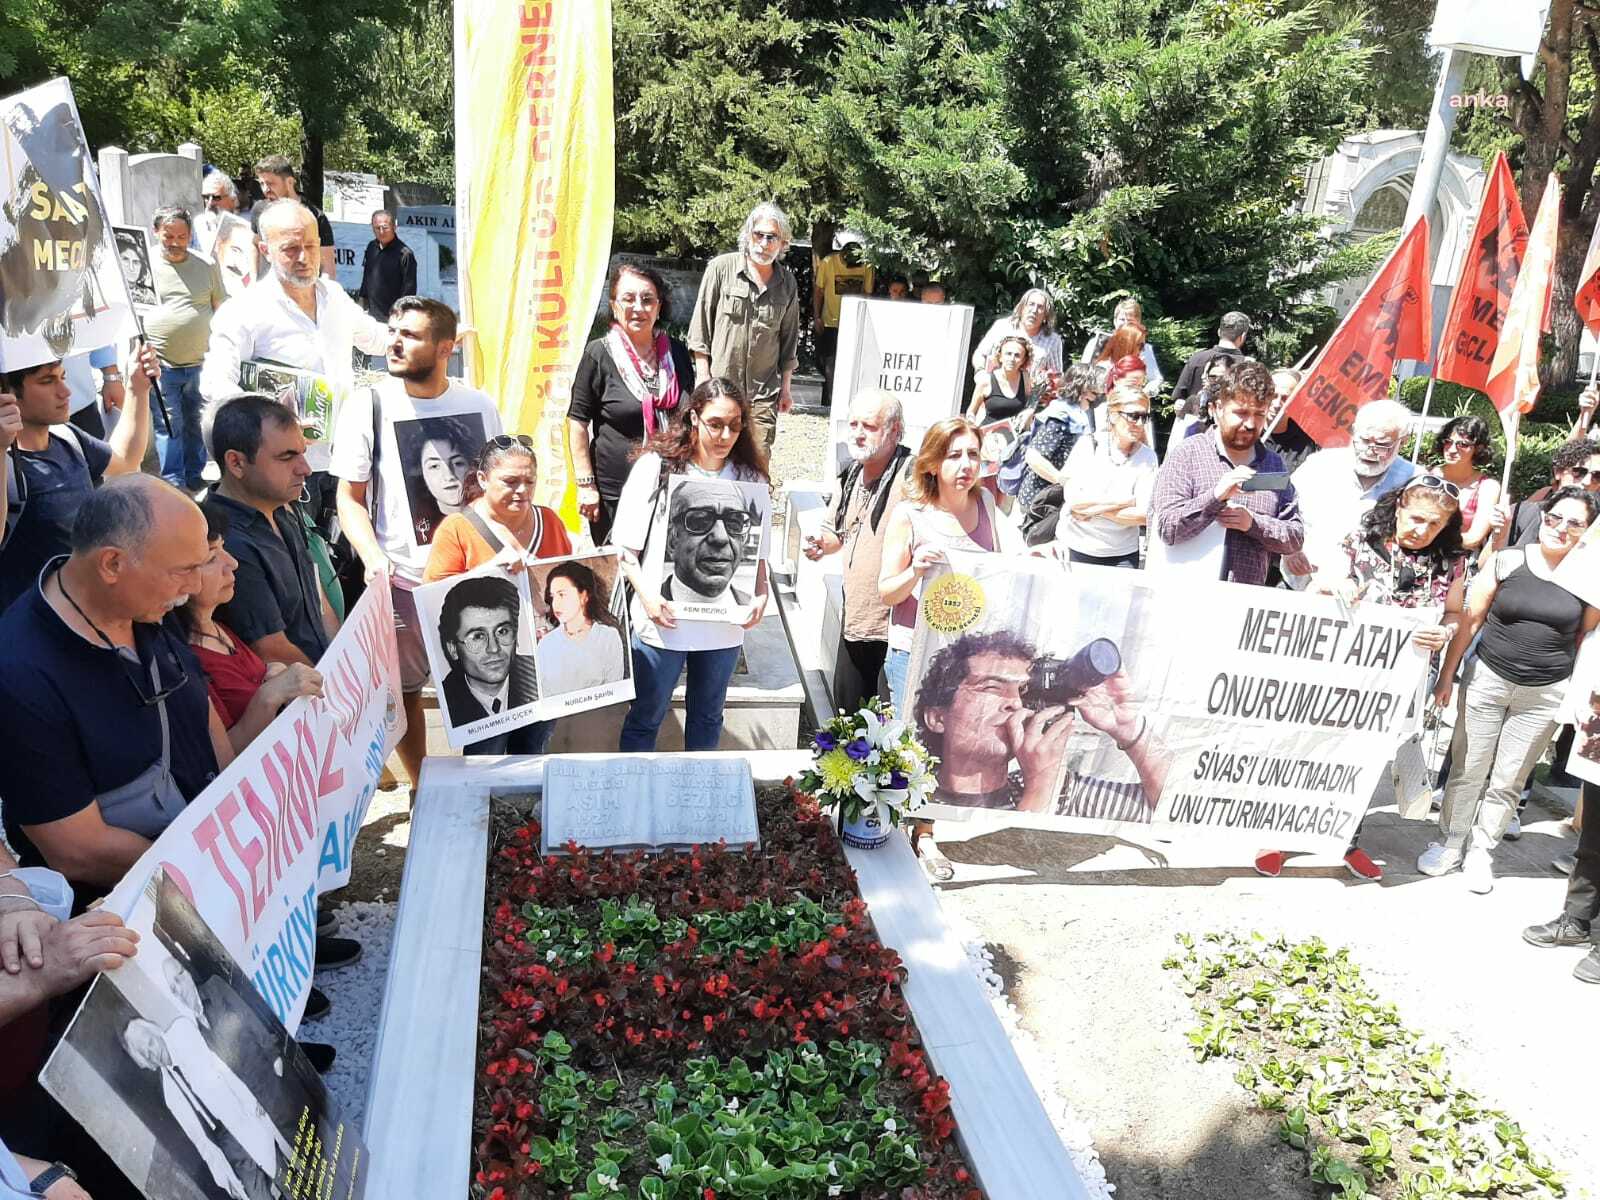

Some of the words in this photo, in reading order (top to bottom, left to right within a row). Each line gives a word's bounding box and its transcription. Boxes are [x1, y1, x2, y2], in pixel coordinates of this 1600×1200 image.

[406, 215, 437, 228] AKIN
[528, 175, 569, 350] KÜLTÜR
[882, 352, 921, 371] RIFAT
[879, 374, 922, 393] ILGAZ
[1307, 374, 1357, 434] GENÇ
[1237, 607, 1349, 663] MEHMET
[1344, 623, 1413, 670] ATAY
[564, 696, 593, 707] NURCAN
[1207, 672, 1401, 732] ONURUMUZDUR!
[1257, 757, 1363, 795] UNUTMADIK
